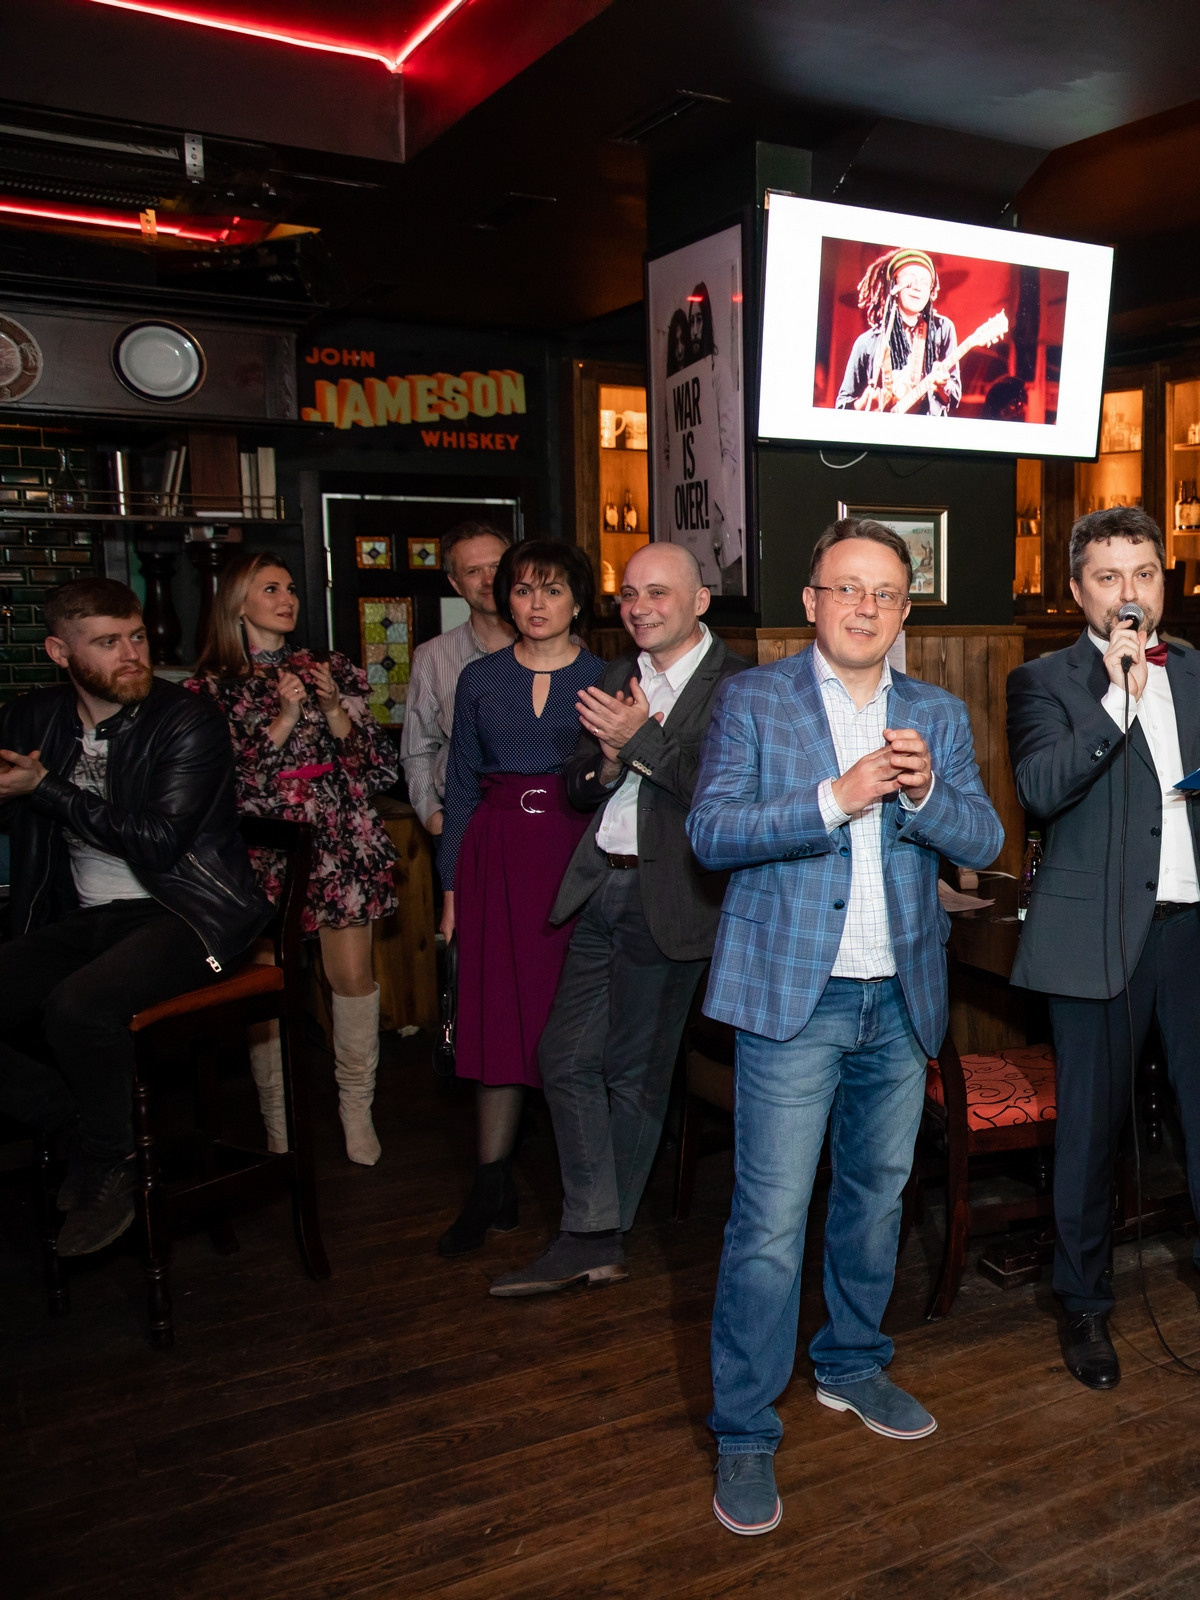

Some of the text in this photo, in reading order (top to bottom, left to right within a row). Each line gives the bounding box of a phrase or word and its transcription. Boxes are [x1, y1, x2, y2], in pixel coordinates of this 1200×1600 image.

[305, 347, 375, 368] JOHN
[301, 369, 527, 430] JAMESON
[673, 376, 702, 432] WAR
[420, 430, 519, 450] WHISKEY
[682, 430, 695, 480] IS
[675, 479, 710, 530] OVER!
